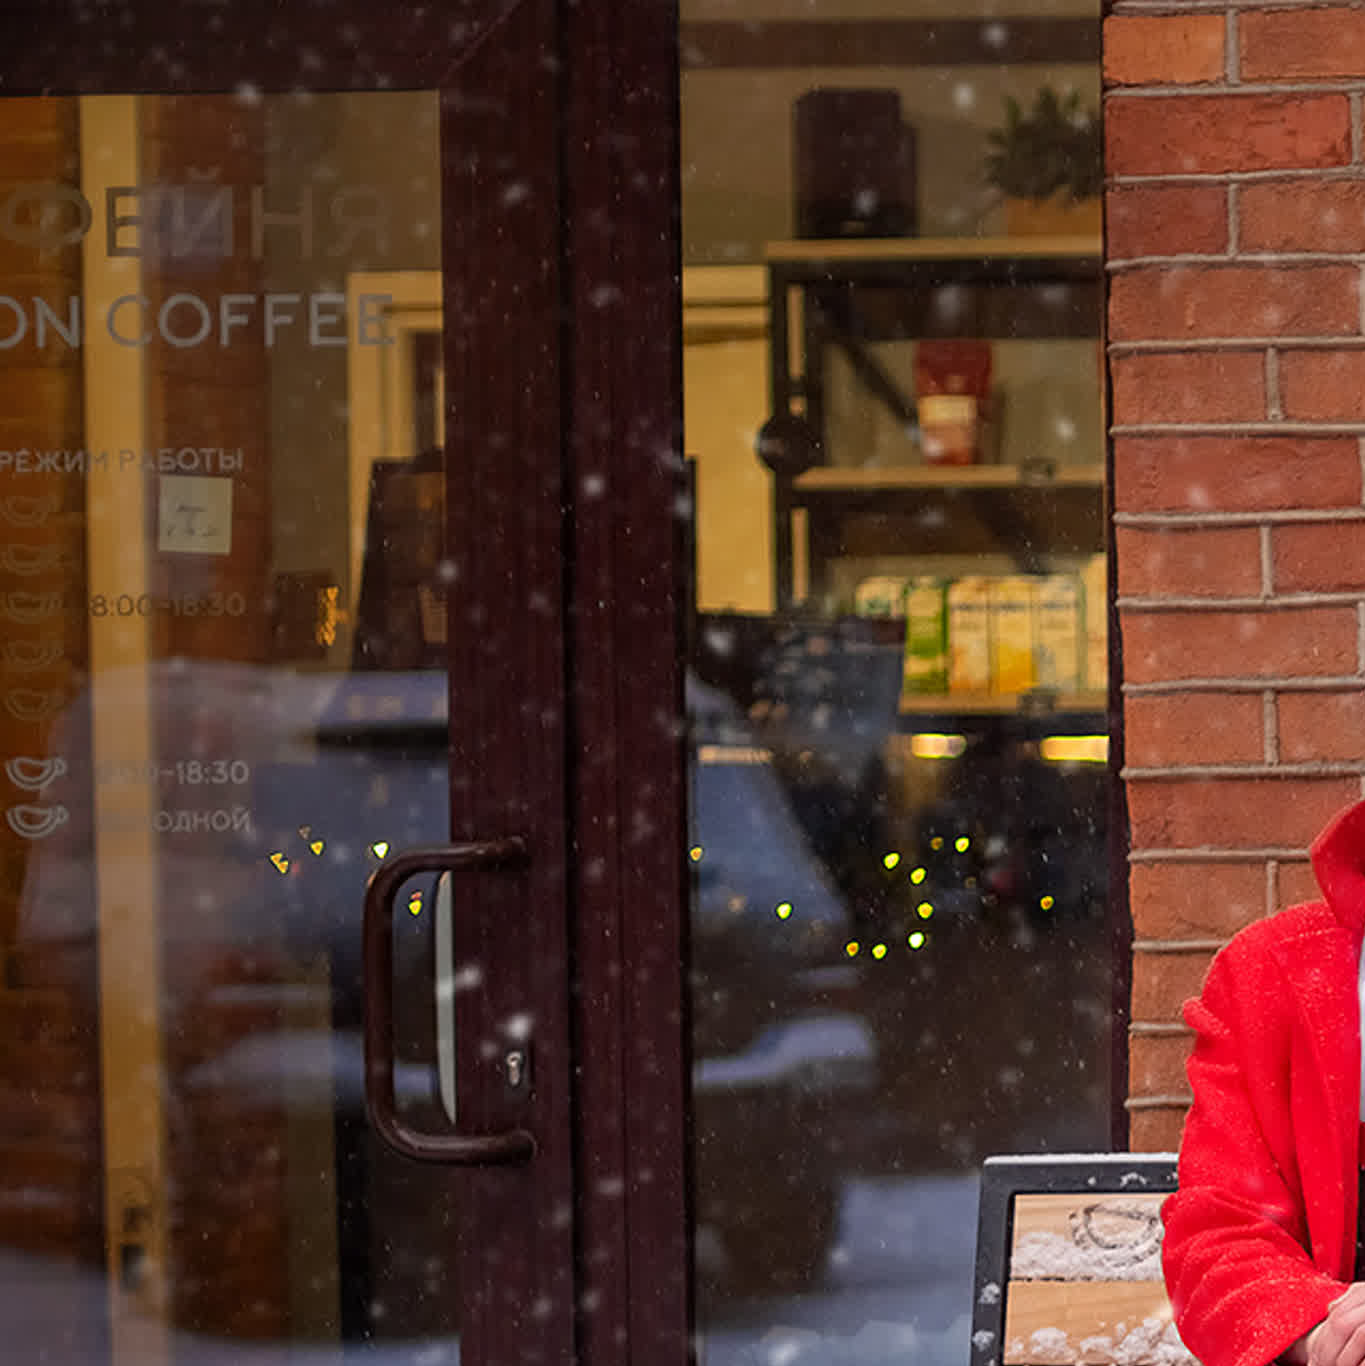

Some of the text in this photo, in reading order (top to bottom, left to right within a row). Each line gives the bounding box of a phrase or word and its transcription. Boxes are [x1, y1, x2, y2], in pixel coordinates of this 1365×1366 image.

[106, 292, 395, 348] COFFEE
[0, 447, 244, 474] РЕЖИМ РАБОТЫ
